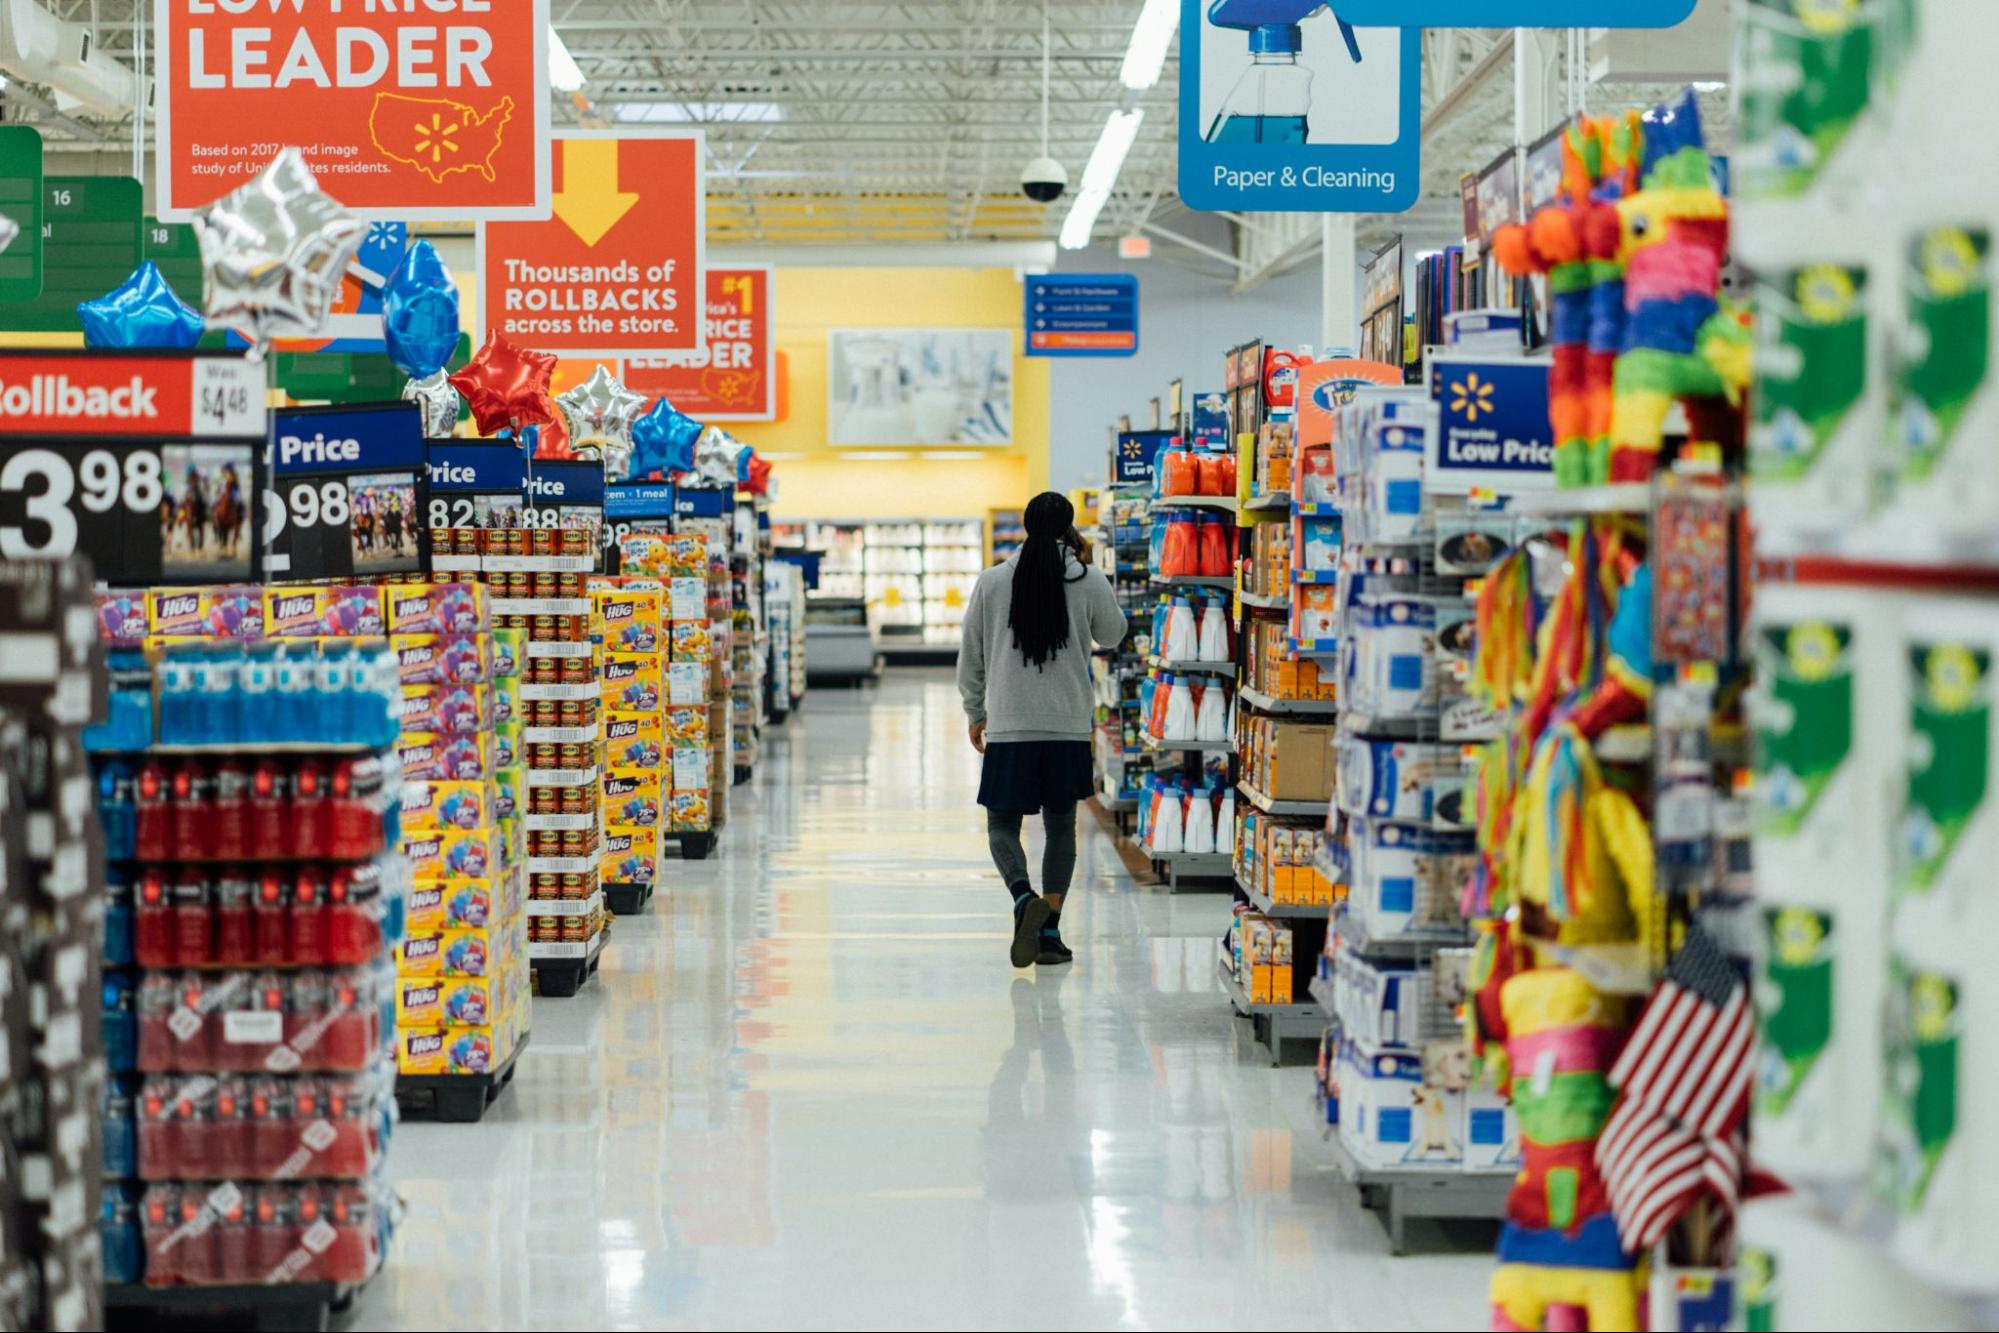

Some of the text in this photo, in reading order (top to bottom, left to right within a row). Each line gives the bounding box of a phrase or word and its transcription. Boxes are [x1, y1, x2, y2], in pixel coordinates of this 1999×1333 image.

[188, 26, 493, 88] LEADER
[191, 144, 230, 156] Based
[231, 147, 247, 156] on
[251, 144, 279, 156] 2017
[320, 144, 358, 158] image
[191, 162, 225, 176] study
[229, 162, 241, 174] of
[332, 162, 391, 174] residents.
[1214, 165, 1395, 193] Paper & Cleaning
[52, 190, 71, 206] 16
[152, 229, 168, 244] 18
[504, 259, 676, 283] Thousands of
[505, 288, 677, 311] ROLLBACKS
[504, 313, 679, 333] across the store.
[705, 318, 752, 338] RICE
[0, 375, 158, 418] ollback
[281, 433, 360, 464] Price
[1448, 437, 1500, 462] Low
[1503, 438, 1552, 464] Pric
[1124, 466, 1145, 476] Low
[642, 488, 668, 498] meal
[290, 481, 348, 528] 98
[429, 499, 474, 529] 82
[162, 596, 197, 618] HUG
[278, 595, 313, 619] HUG
[606, 603, 633, 620] HUG
[610, 722, 636, 738] HUG
